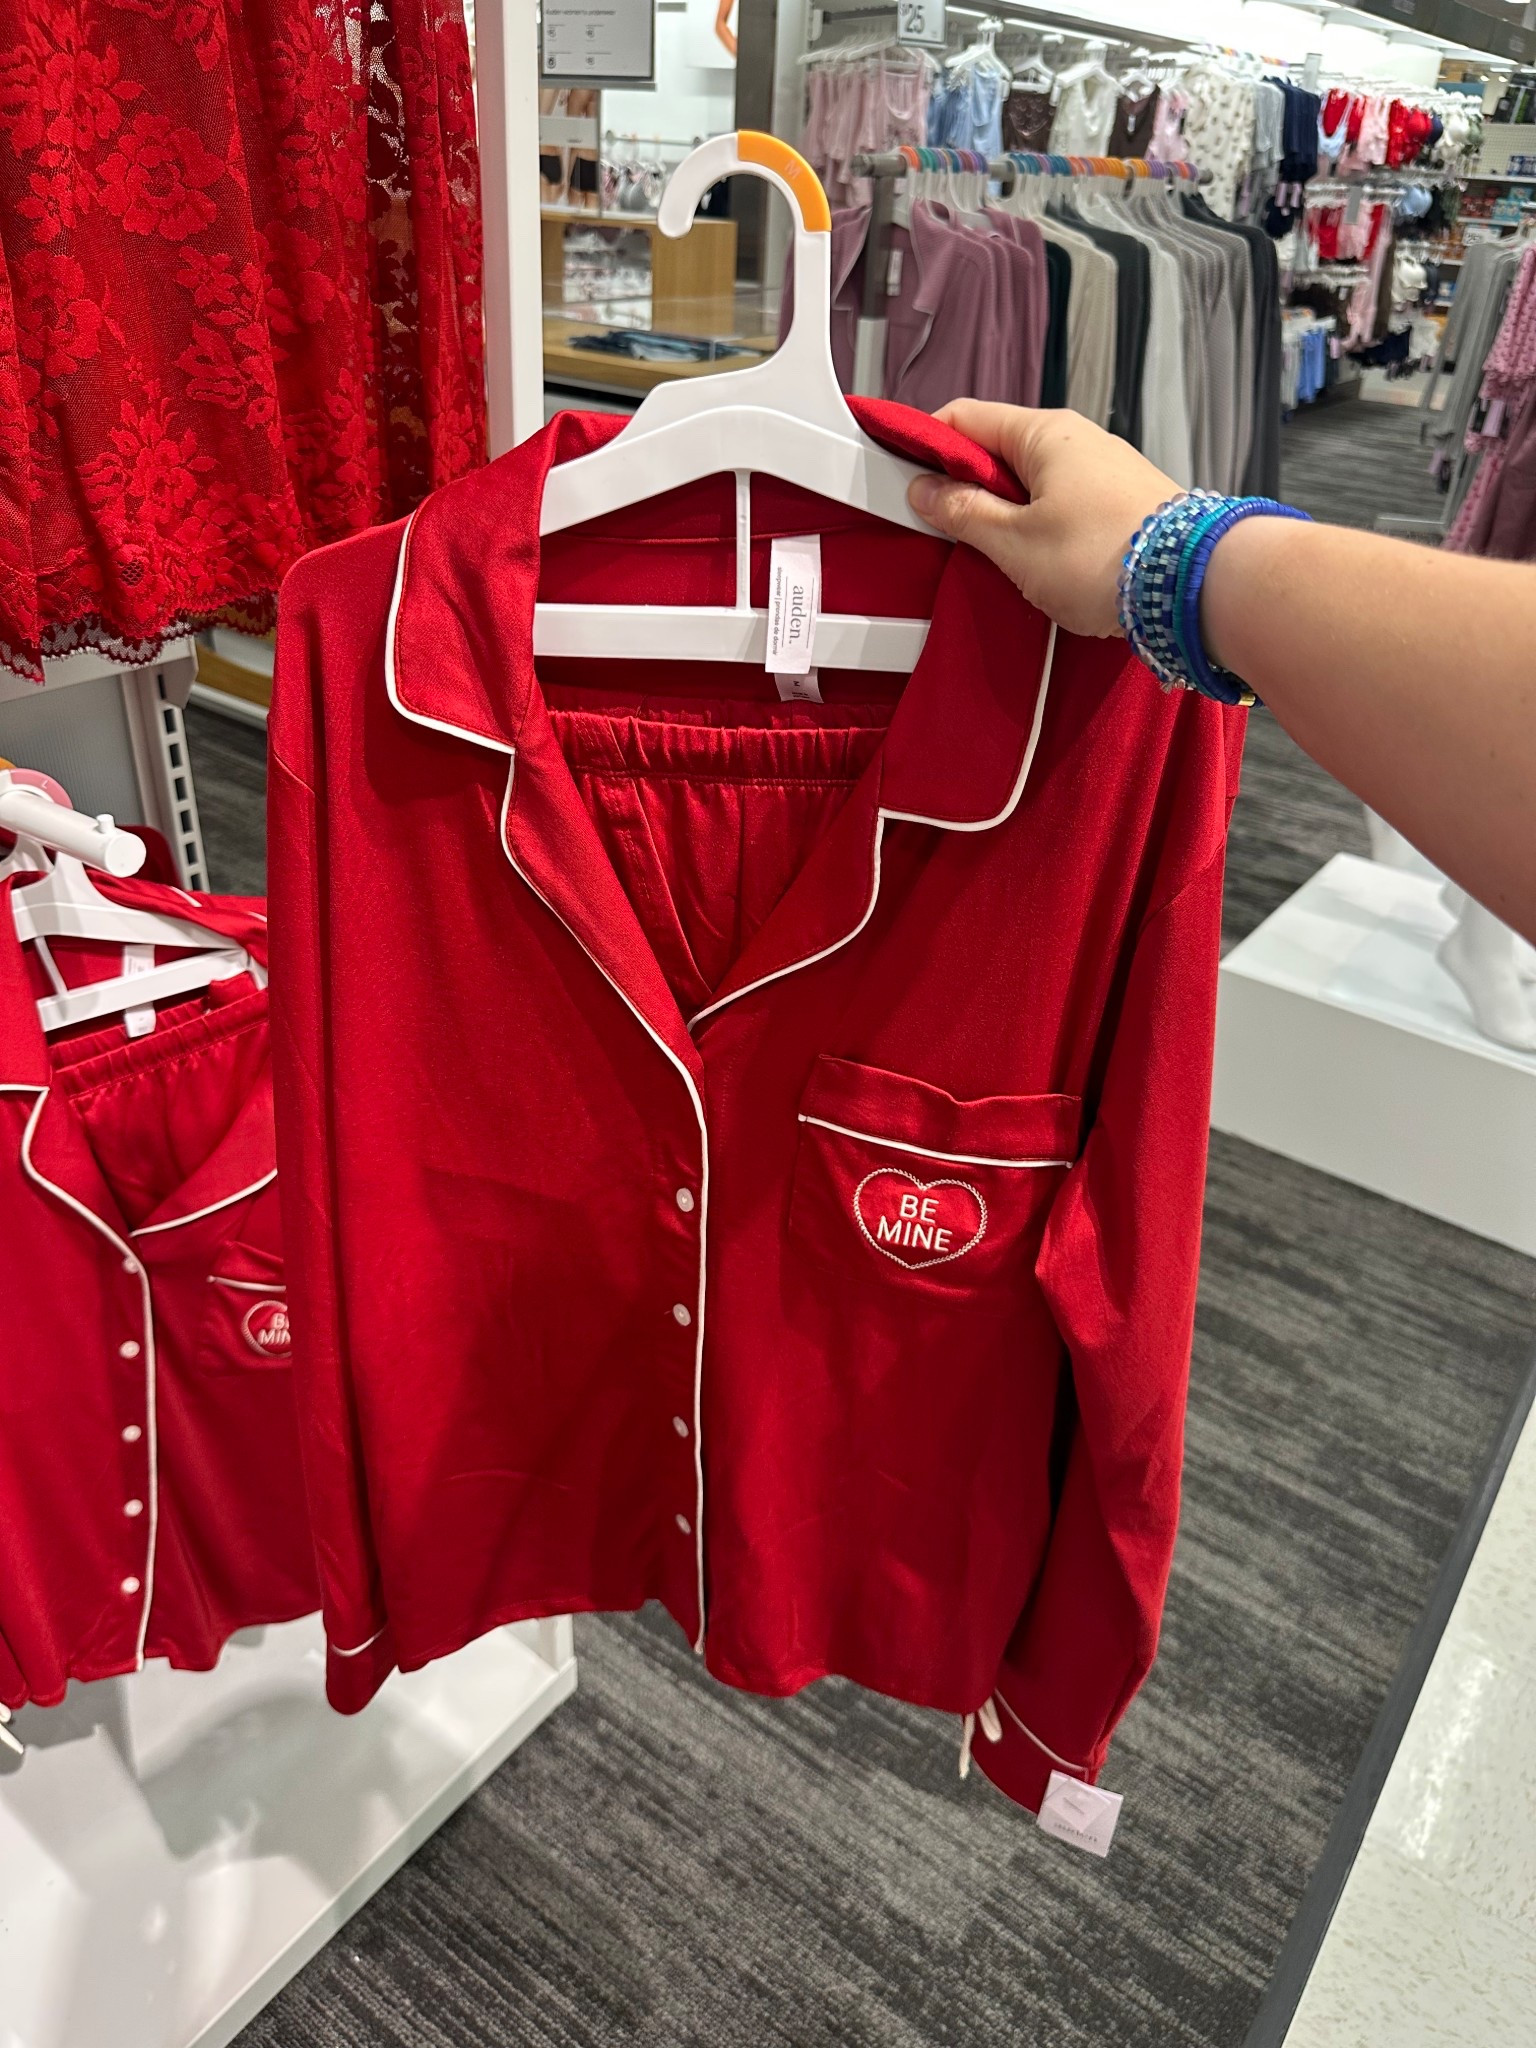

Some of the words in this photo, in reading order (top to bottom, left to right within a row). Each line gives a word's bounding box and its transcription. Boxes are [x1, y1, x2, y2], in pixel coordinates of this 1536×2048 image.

[784, 160, 801, 180] M
[41, 779, 49, 790] L
[900, 1194, 940, 1224] BE
[877, 1215, 953, 1252] MINE
[257, 1328, 291, 1346] MIN
